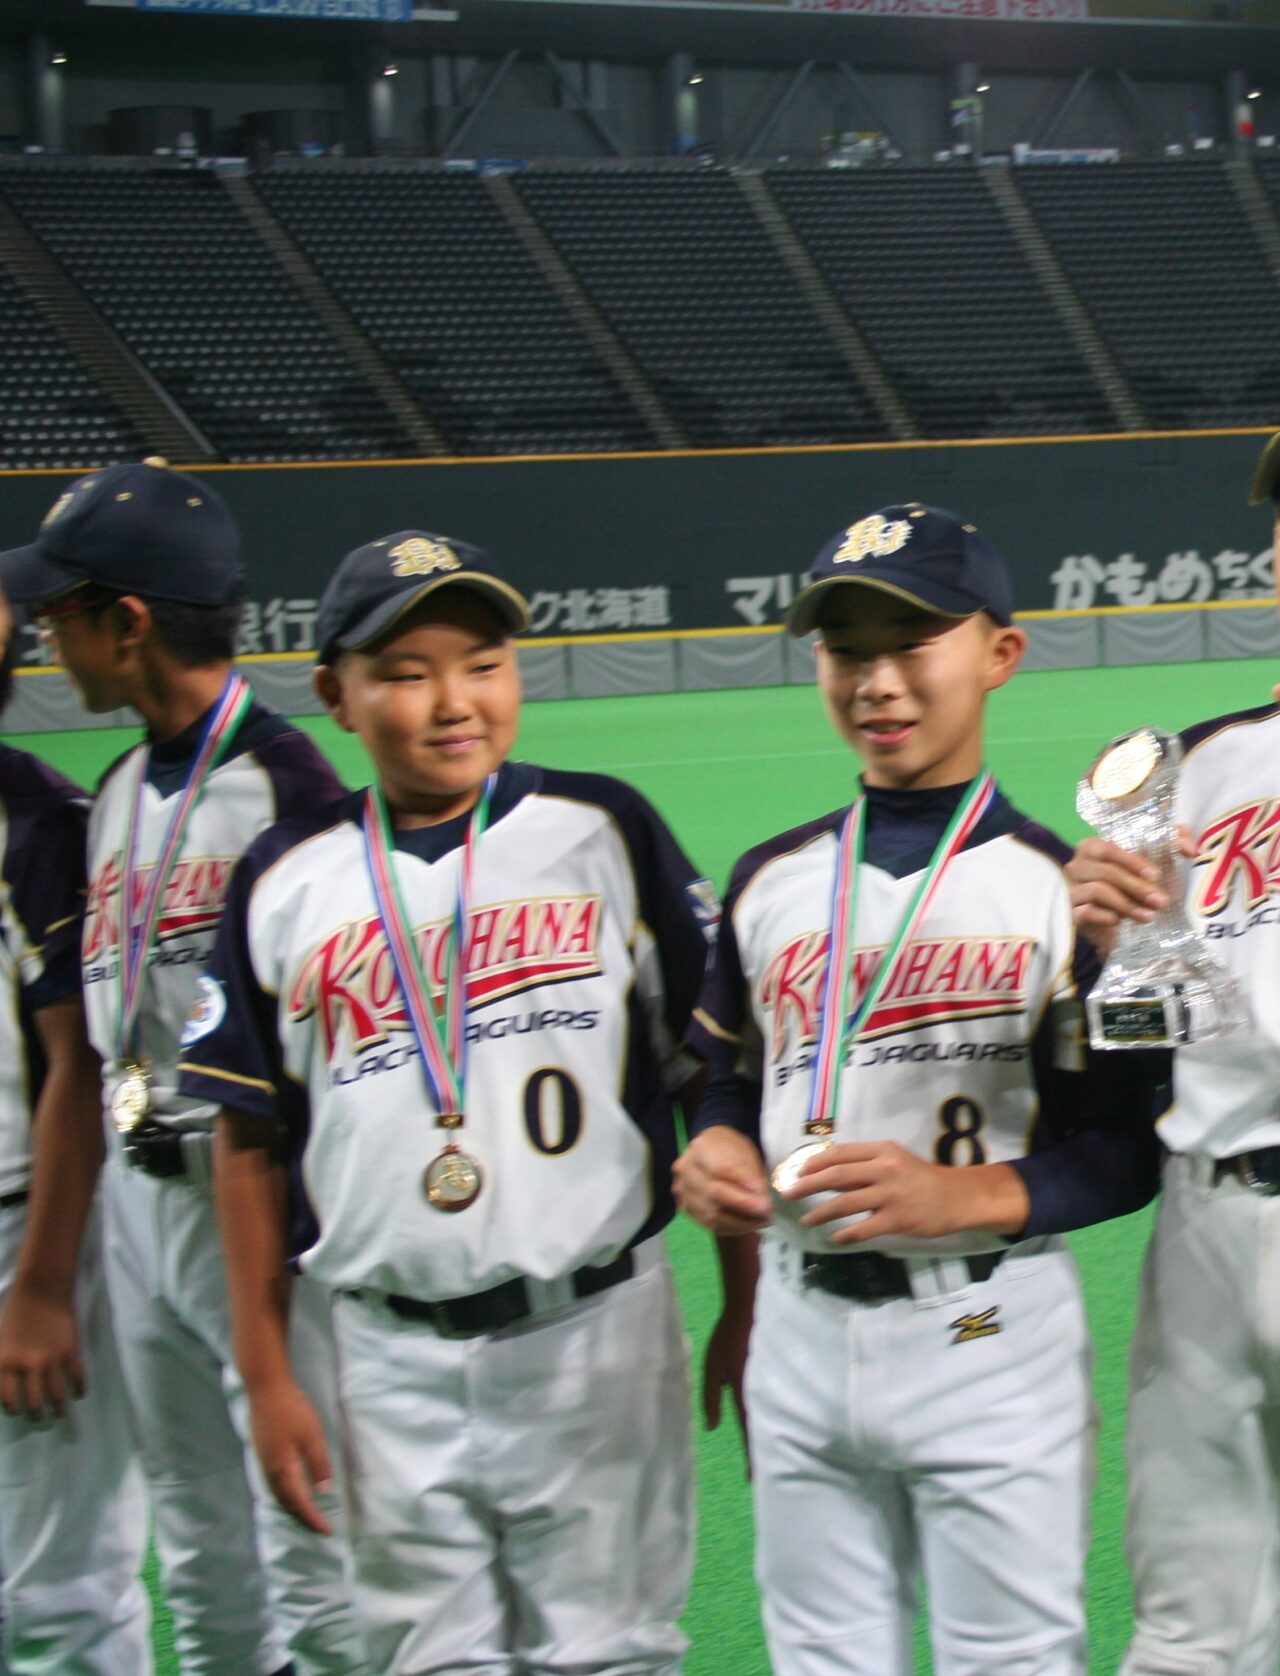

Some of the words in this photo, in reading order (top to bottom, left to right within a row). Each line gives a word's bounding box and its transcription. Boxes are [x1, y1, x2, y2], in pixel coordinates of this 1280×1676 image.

[287, 892, 604, 1066] KOHANA
[758, 930, 1037, 1063] KNHANA
[464, 1009, 602, 1045] AGUARS
[860, 1042, 1029, 1068] JAGUARS
[523, 1065, 585, 1159] 0
[934, 1095, 987, 1167] 8
